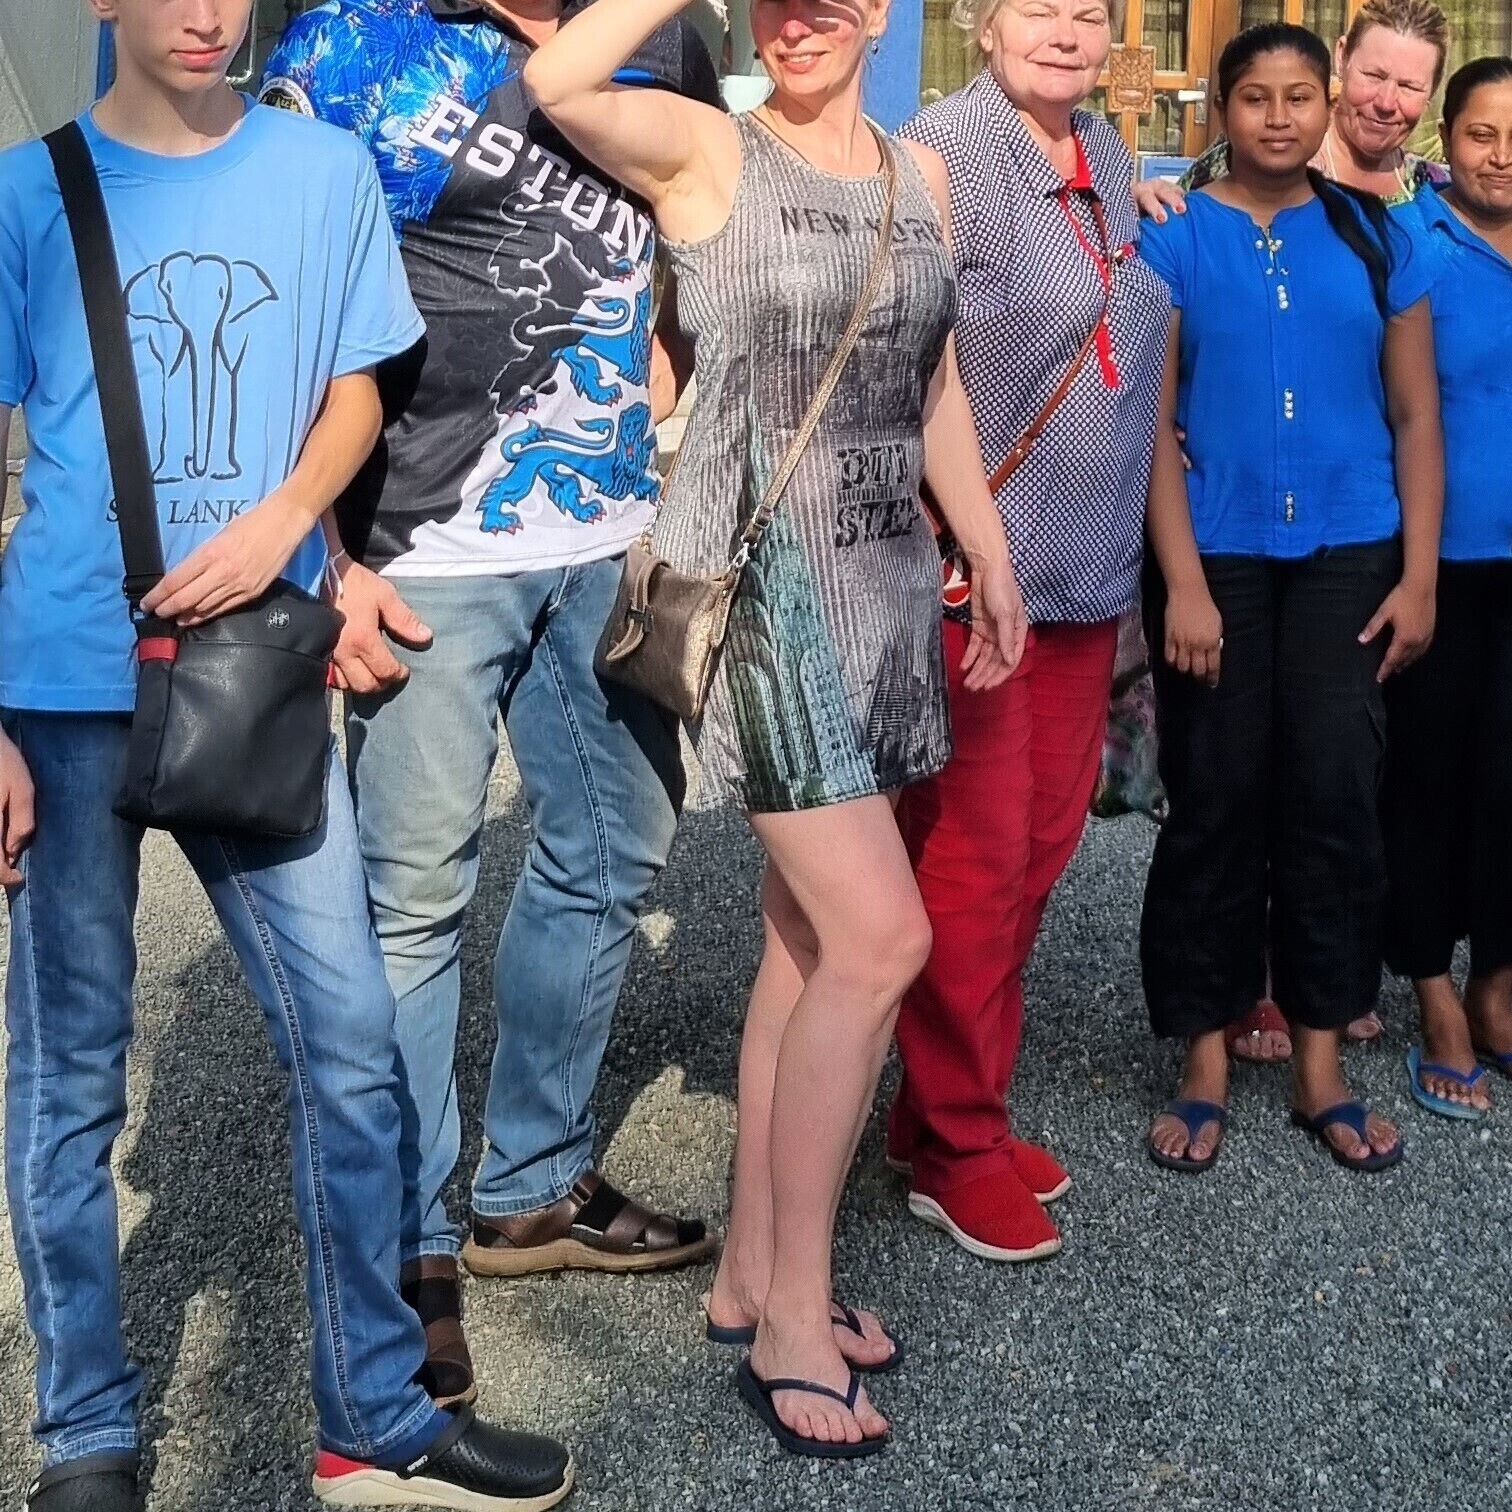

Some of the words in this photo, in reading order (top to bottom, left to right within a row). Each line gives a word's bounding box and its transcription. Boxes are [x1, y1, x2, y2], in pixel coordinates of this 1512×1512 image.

[407, 94, 654, 264] ESTON
[779, 205, 850, 237] NEW
[166, 498, 262, 524] LANK
